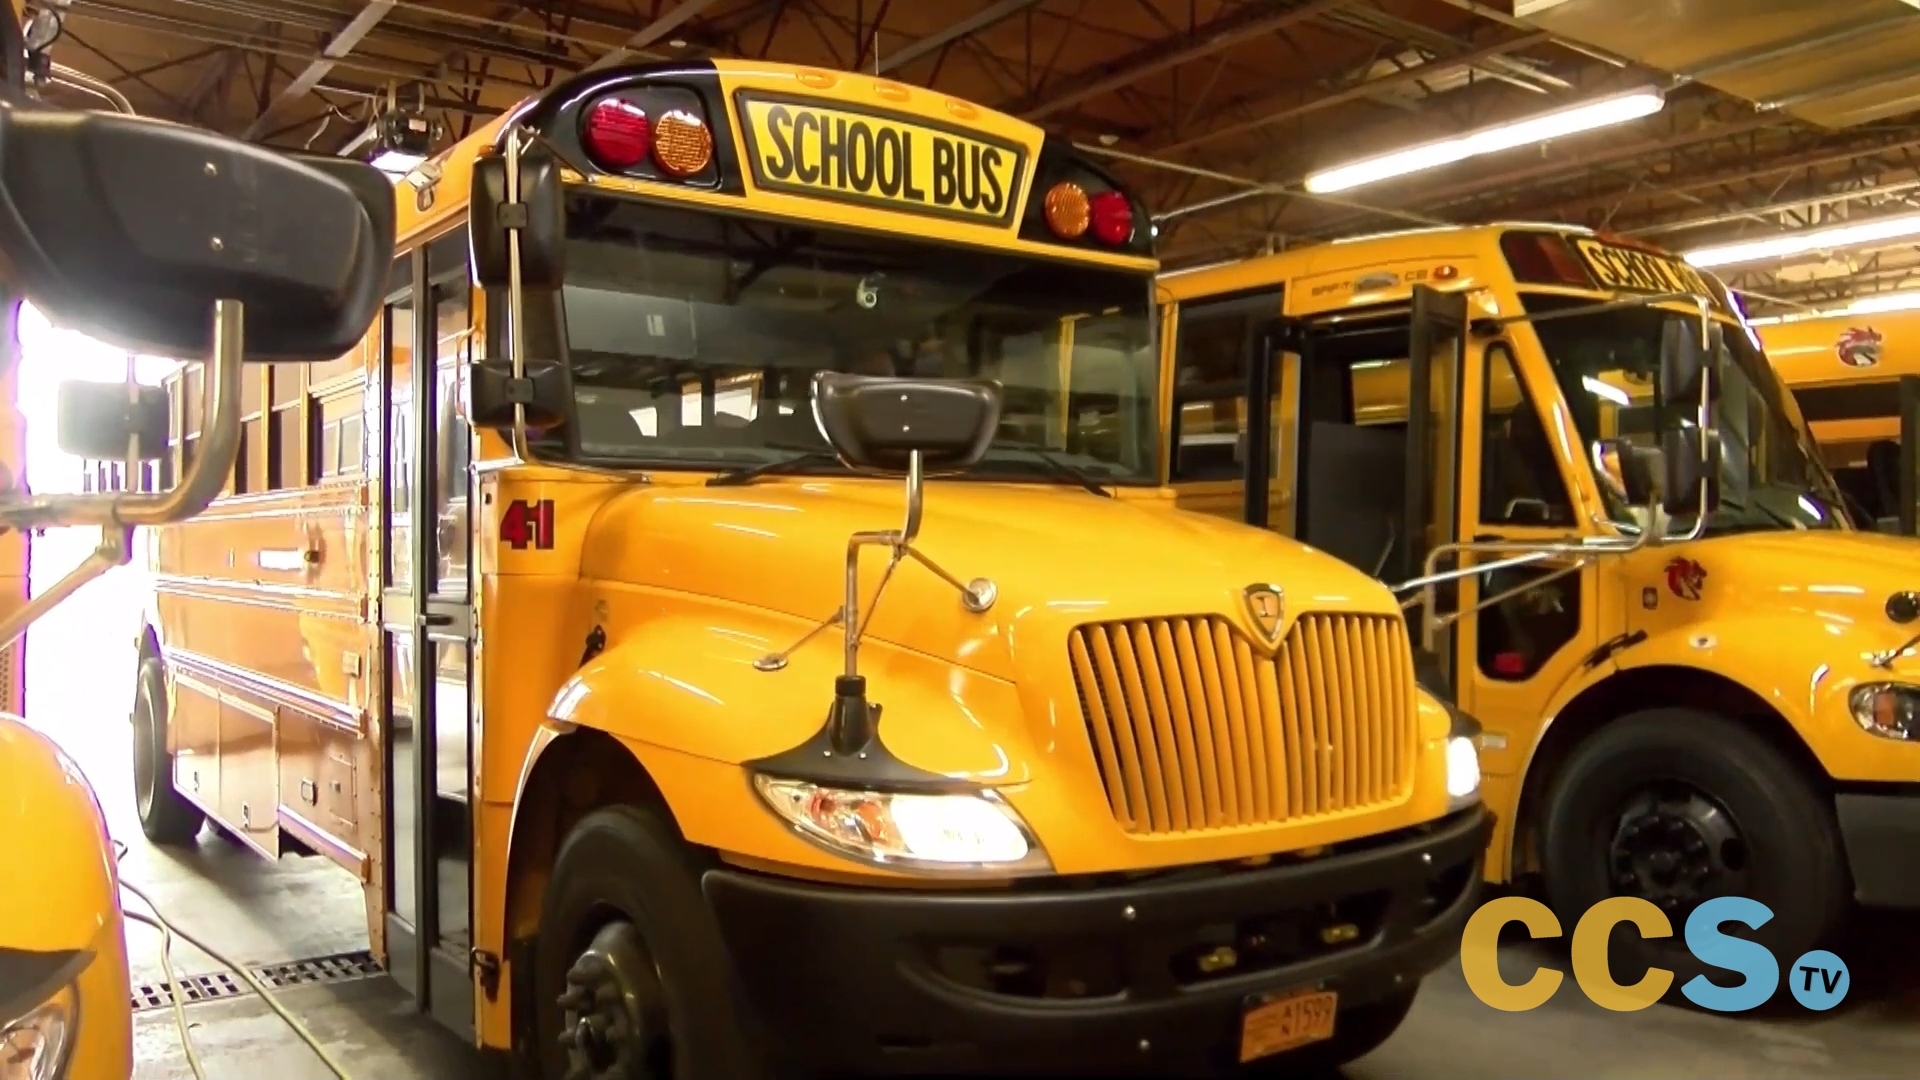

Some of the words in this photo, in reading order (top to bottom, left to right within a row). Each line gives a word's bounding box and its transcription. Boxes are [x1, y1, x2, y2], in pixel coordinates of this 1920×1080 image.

[765, 105, 926, 202] SCHOOL
[932, 137, 1004, 215] BUS
[500, 499, 555, 550] 41
